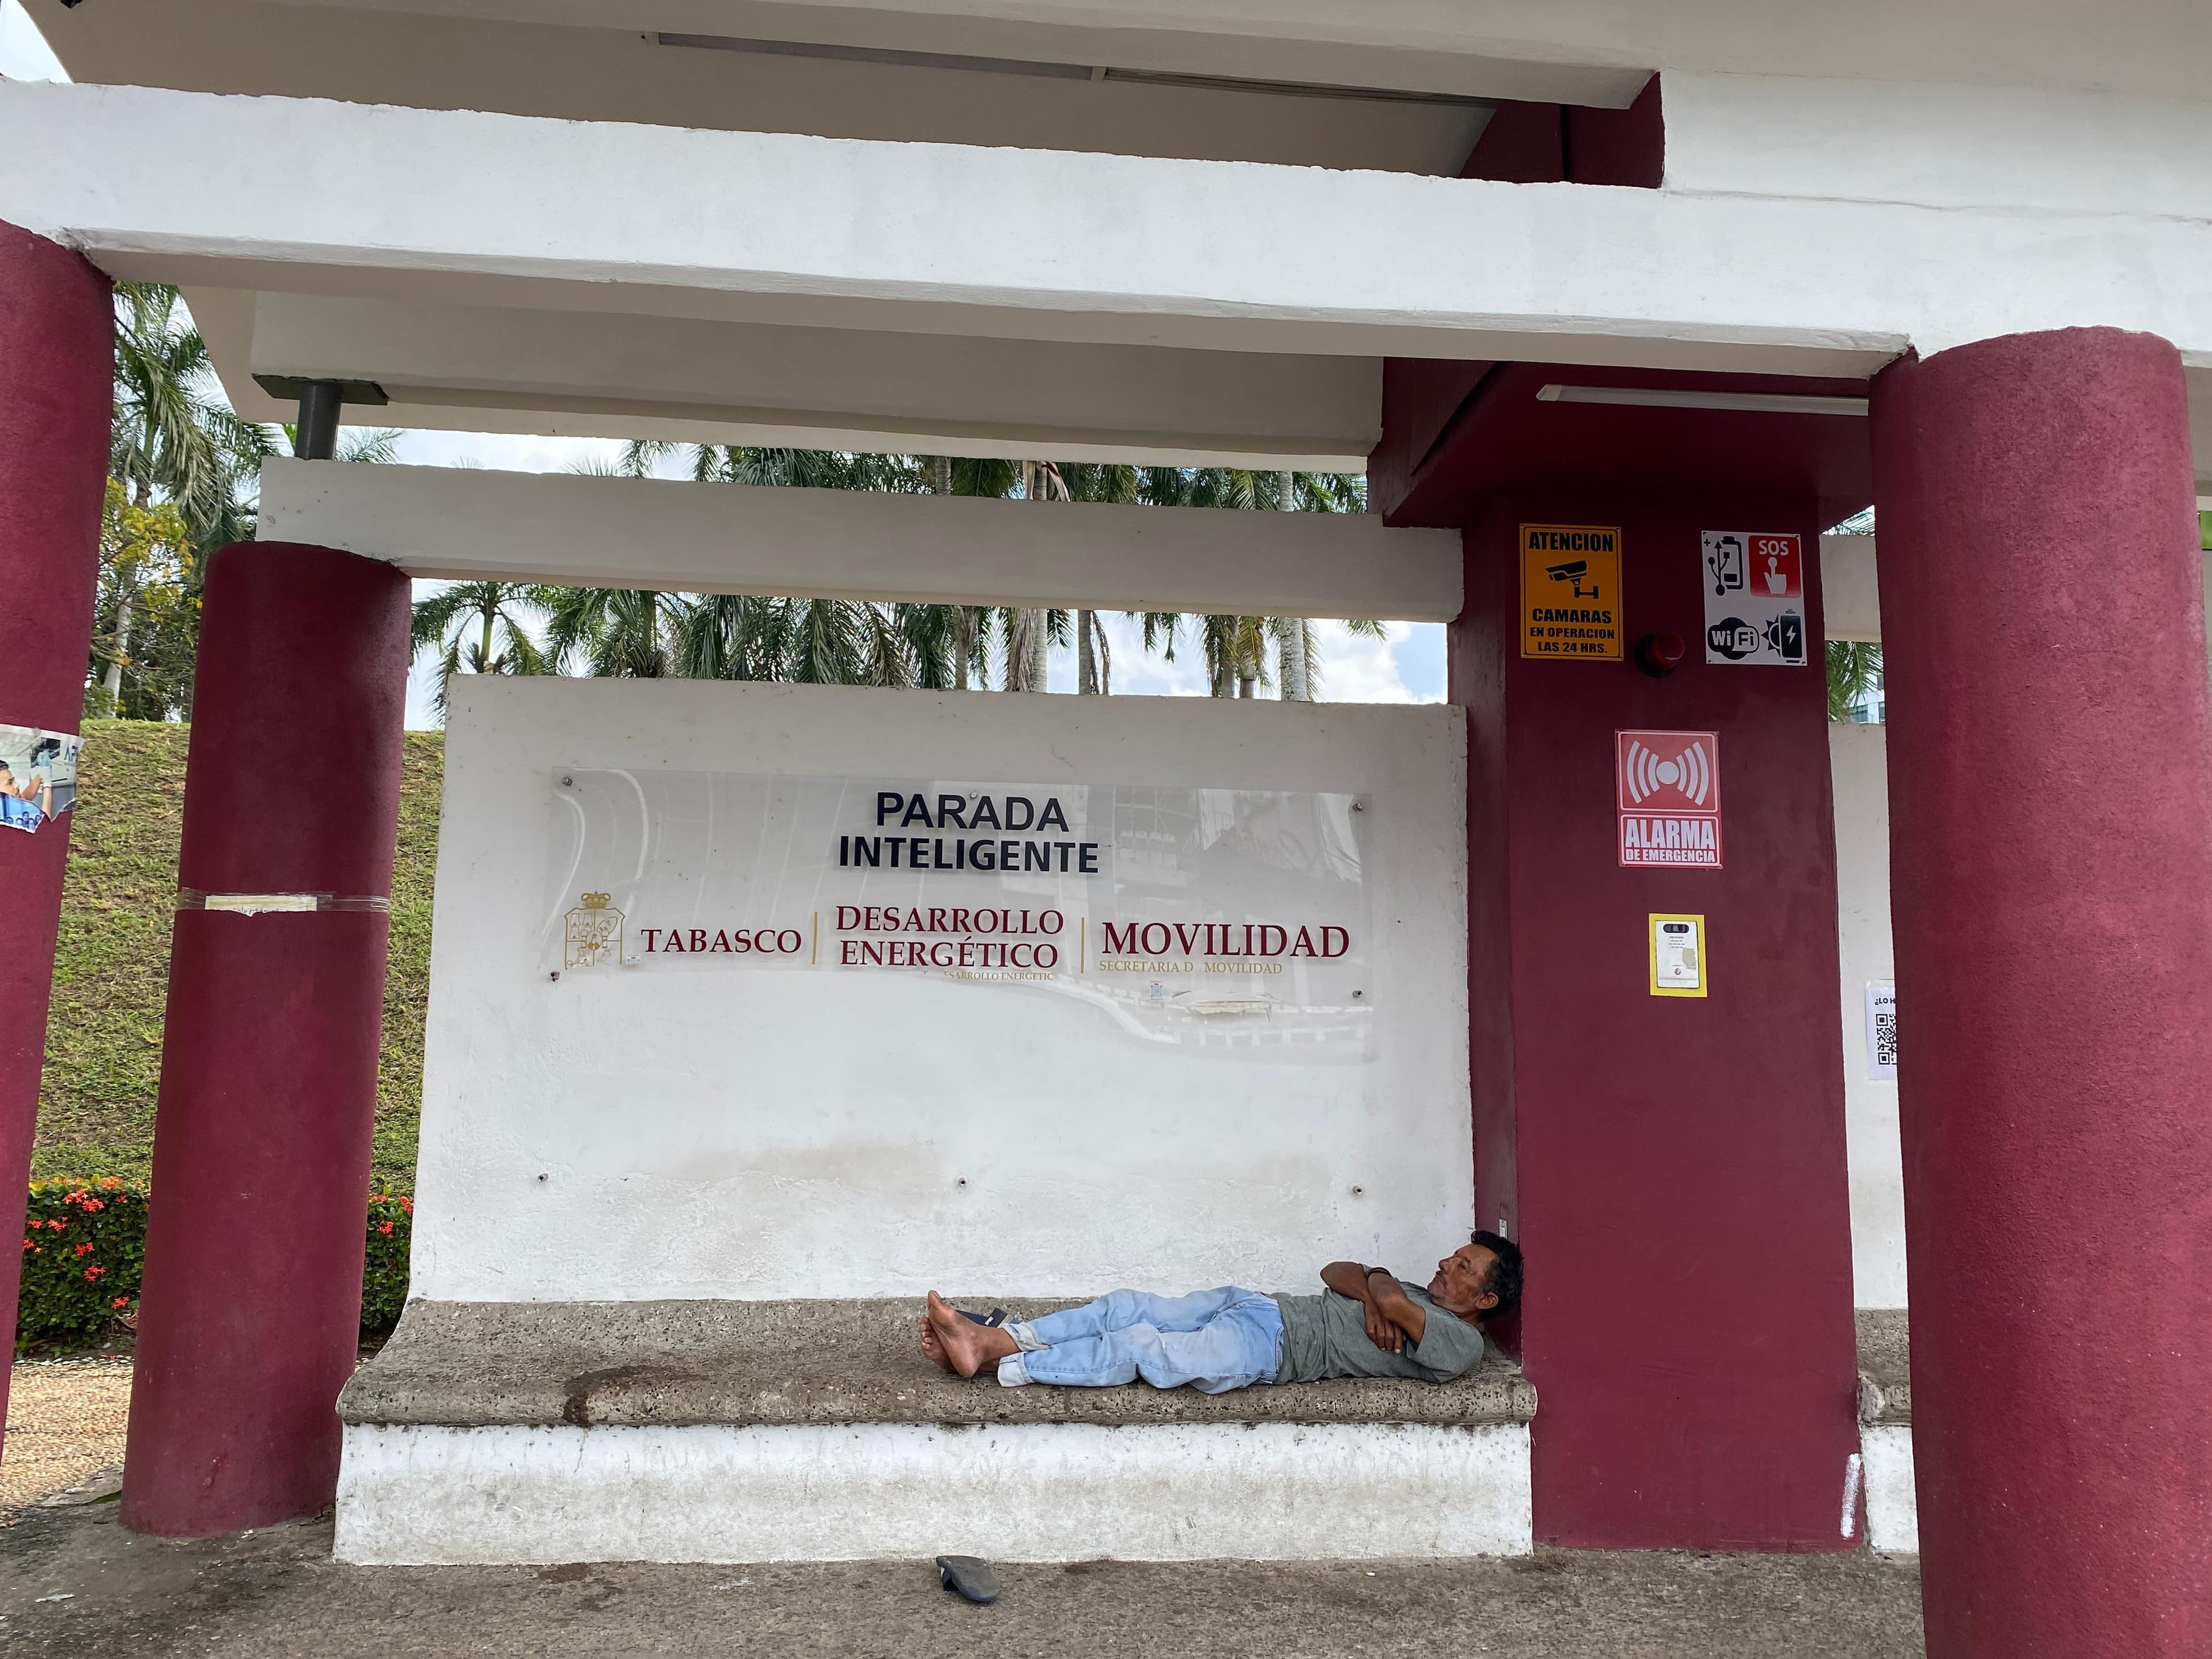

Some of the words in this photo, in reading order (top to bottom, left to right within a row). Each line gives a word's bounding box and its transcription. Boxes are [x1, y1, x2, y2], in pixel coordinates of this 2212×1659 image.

[1529, 532, 1613, 552] ATENCION
[1759, 540, 1789, 556] SOS
[1532, 608, 1612, 624] CAMARAS
[1530, 627, 1544, 637] EN
[1547, 627, 1615, 639] OPERACION
[1538, 641, 1559, 652] LAS
[1562, 642, 1577, 652] 24
[1581, 643, 1608, 653] HRS.
[877, 791, 1069, 832] PARADA
[1625, 819, 1715, 850] ALARMA
[839, 835, 1099, 873] INTELIGENTE
[1626, 849, 1641, 861] DE
[1643, 849, 1715, 862] EMERGENCIA
[836, 906, 1064, 934] DESARROLLO
[641, 929, 801, 953] TABASCO
[1102, 922, 1350, 957] MOVILIDAD
[840, 936, 1058, 968] ENERGÉTICO
[1100, 960, 1180, 972] SECRETARIA
[1204, 962, 1282, 974] MOVILIDAD
